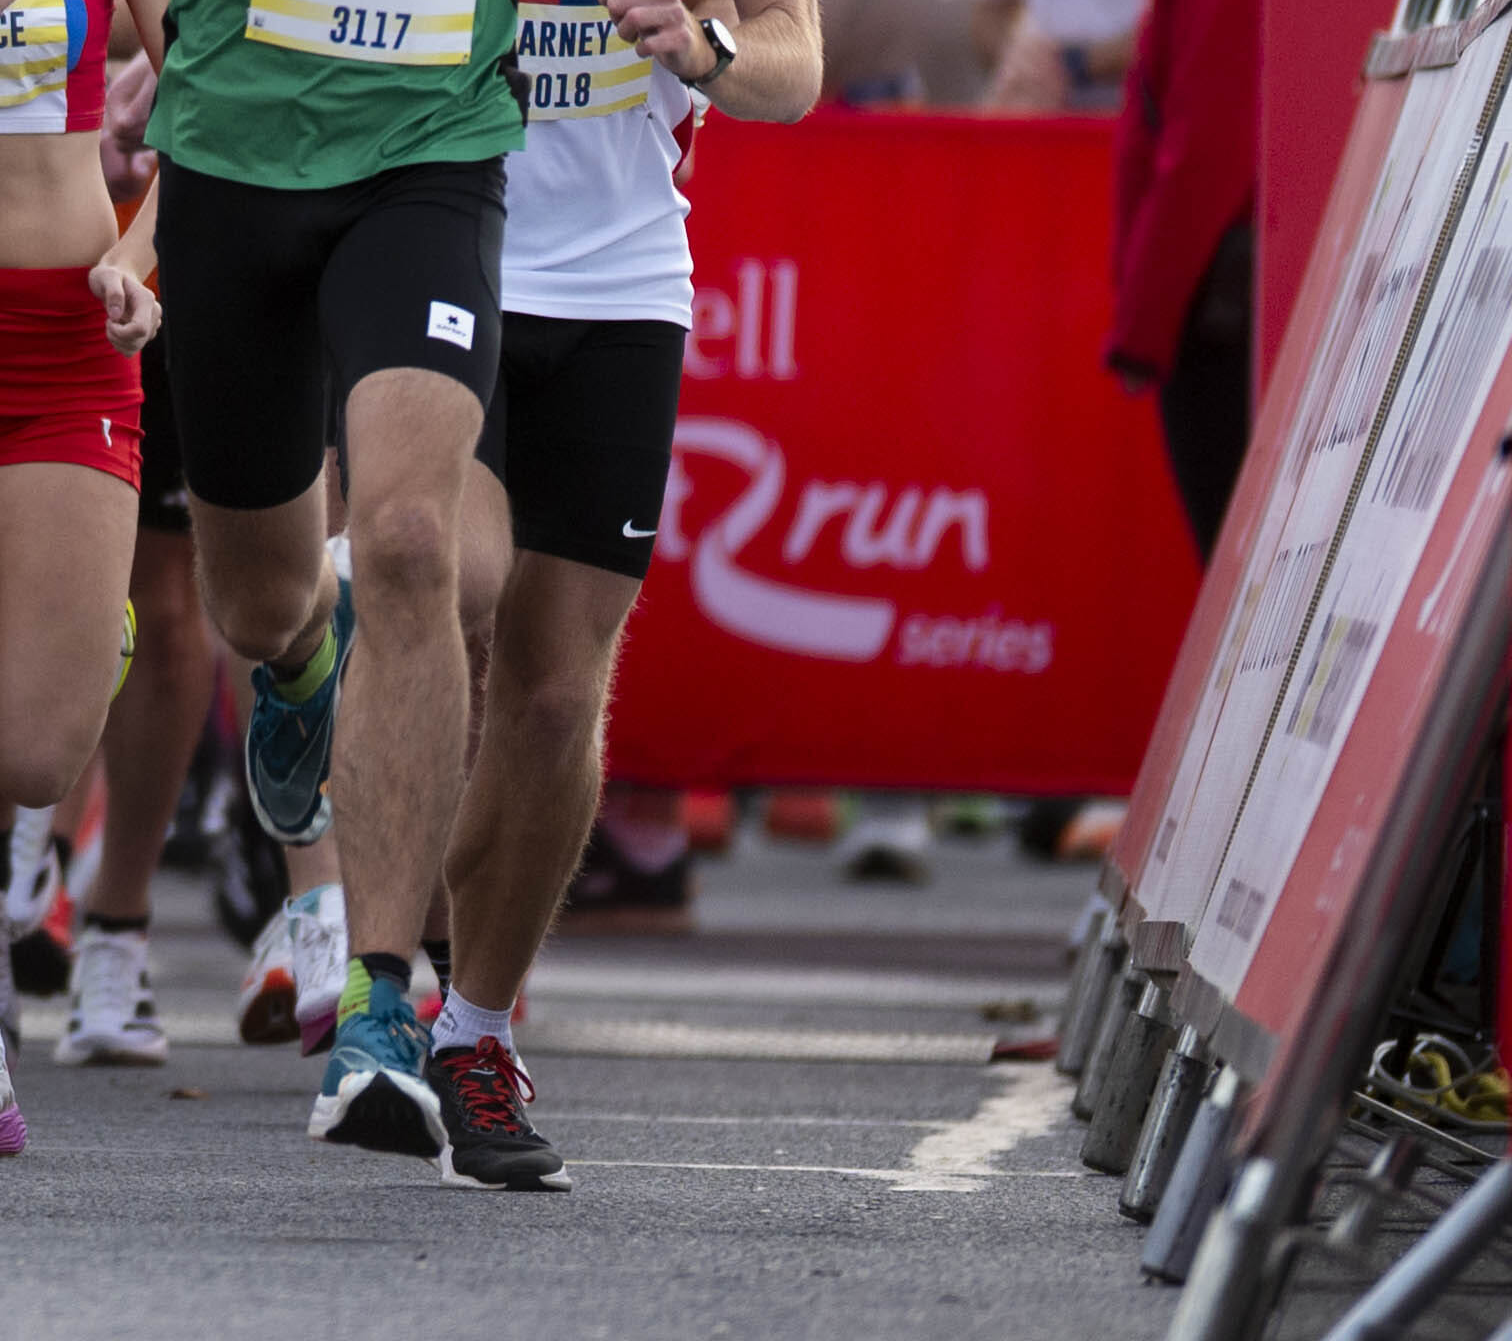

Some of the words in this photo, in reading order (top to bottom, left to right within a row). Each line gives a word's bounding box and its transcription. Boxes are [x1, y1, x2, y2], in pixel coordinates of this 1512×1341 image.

[329, 5, 412, 50] 3117
[527, 72, 592, 109] 018
[782, 478, 989, 573] run
[896, 603, 1053, 674] series
